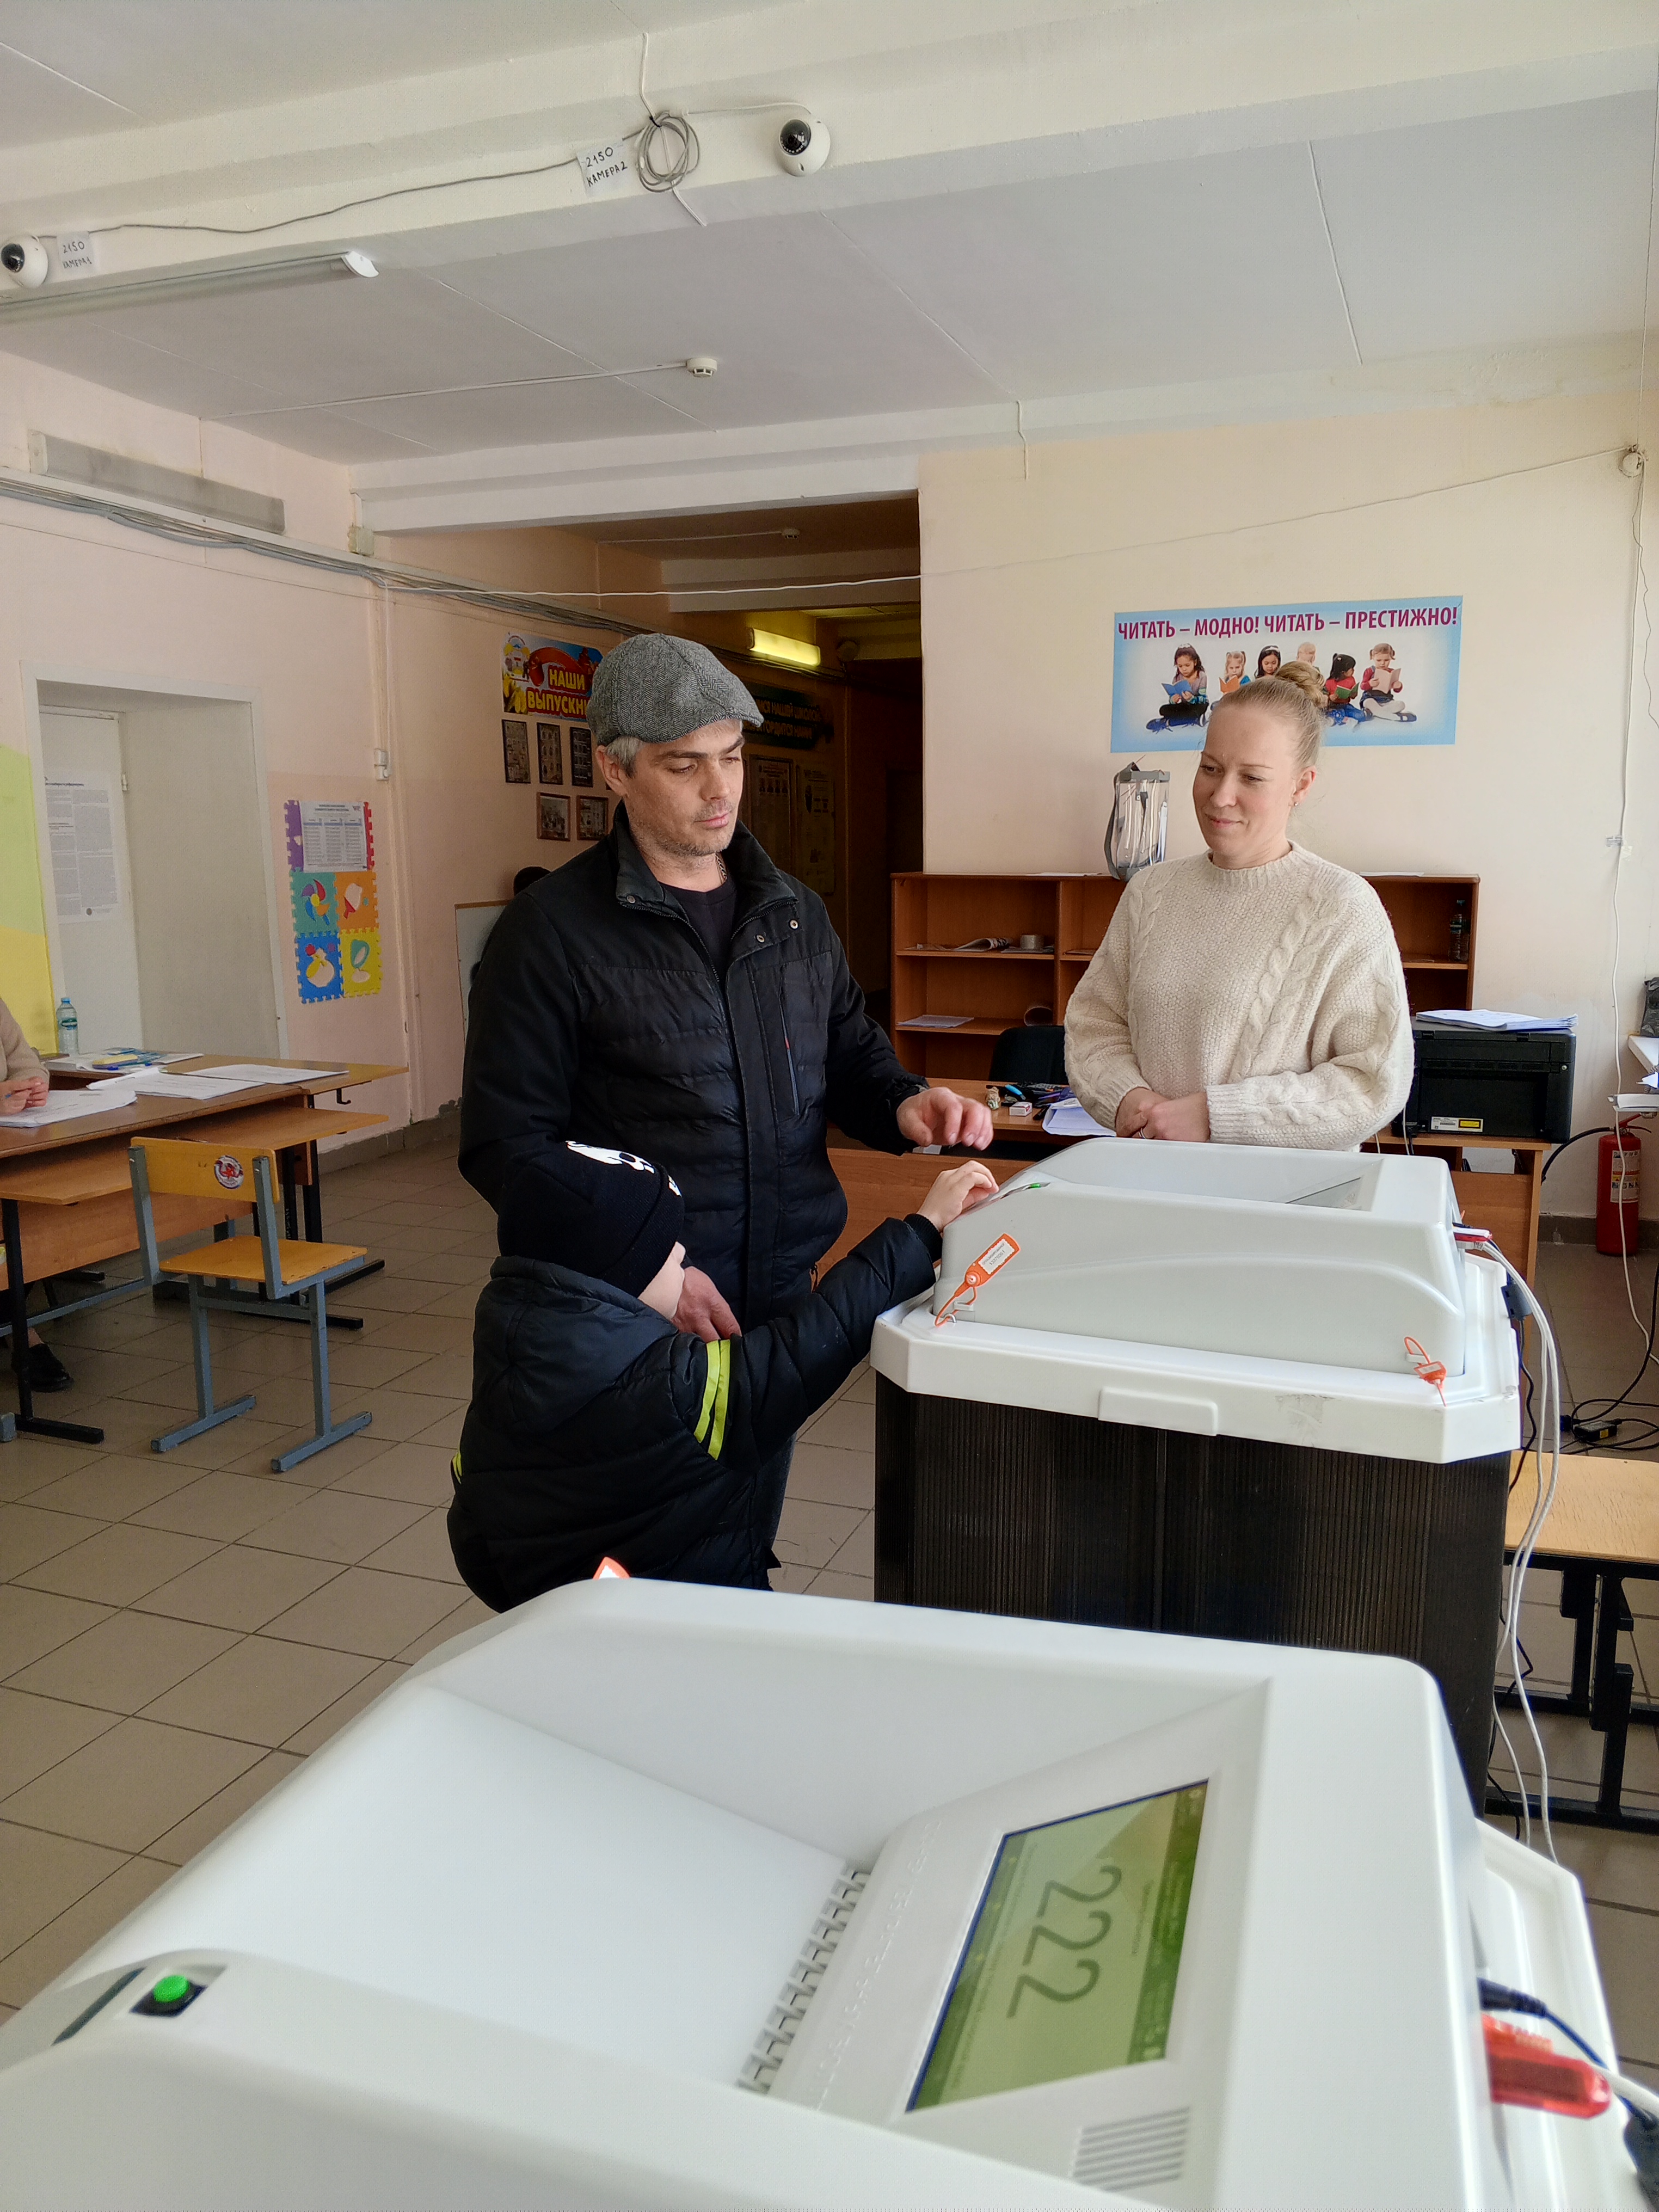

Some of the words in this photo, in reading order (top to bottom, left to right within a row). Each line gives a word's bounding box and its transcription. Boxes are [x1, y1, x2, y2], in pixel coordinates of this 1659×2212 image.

[586, 146, 613, 168] 2150
[63, 241, 85, 254] 2150
[1117, 619, 1176, 641] ЧИТАТЬ
[1194, 616, 1261, 639] МОДНО!
[1264, 612, 1325, 634] ЧИТАТЬ
[1344, 605, 1458, 630] ПРЕСТИЖНО!
[549, 668, 585, 691] НАШИ
[1006, 1865, 1122, 2018] 222
